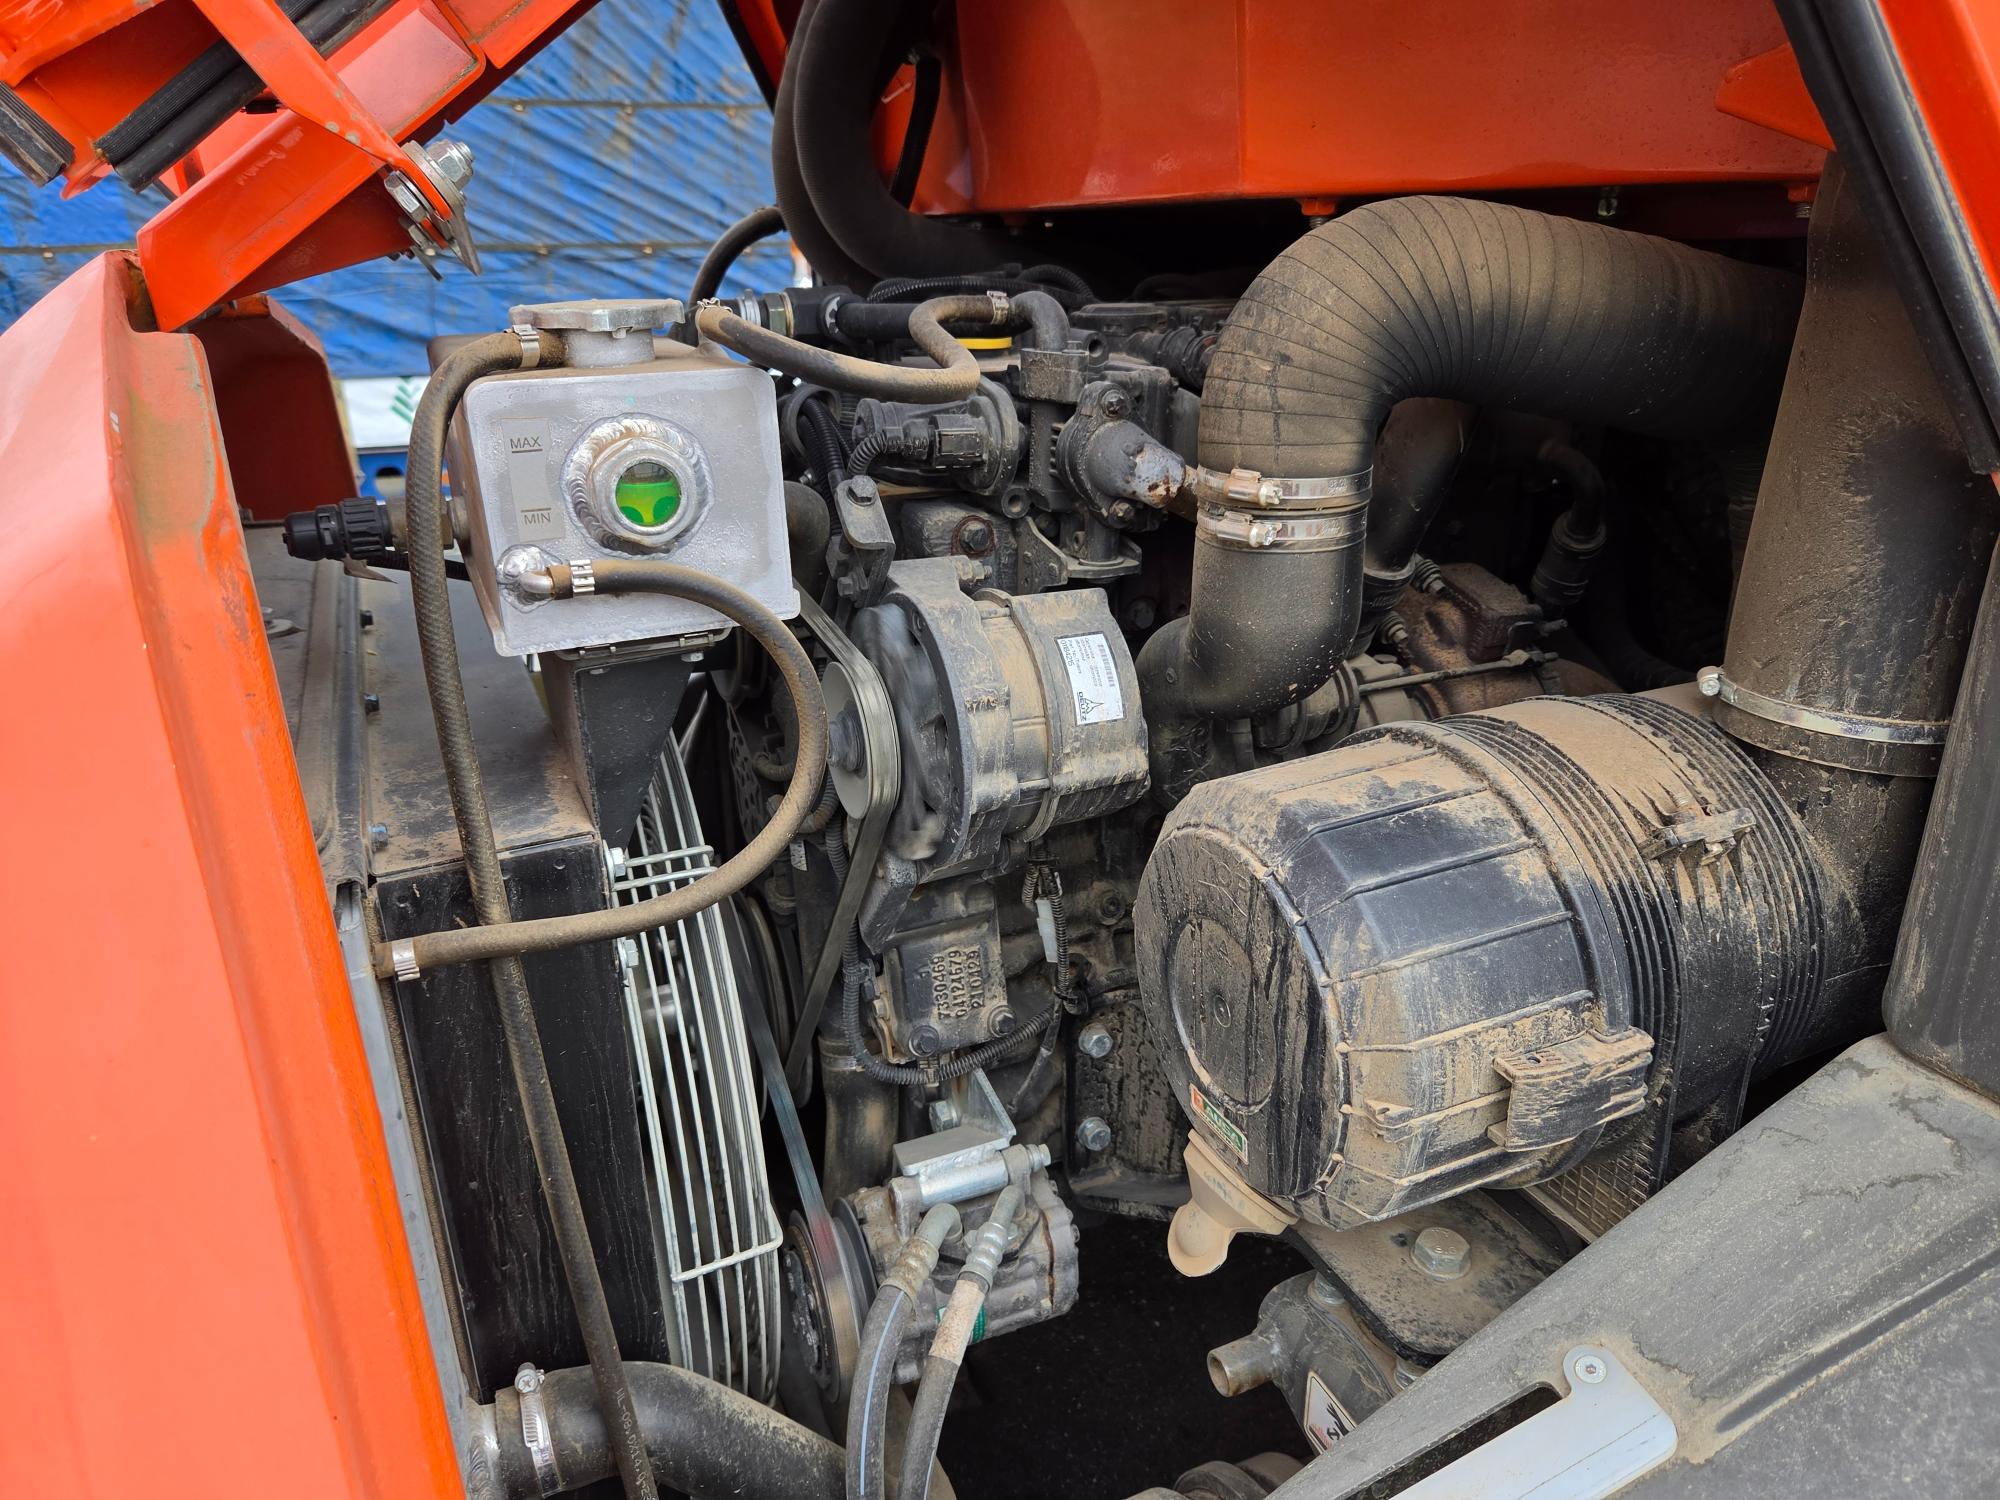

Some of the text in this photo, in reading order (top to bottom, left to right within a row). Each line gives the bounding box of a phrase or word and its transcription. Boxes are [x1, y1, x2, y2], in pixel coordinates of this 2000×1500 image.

[509, 436, 541, 449] MAX
[523, 512, 551, 525] MIN
[1078, 691, 1087, 721] DEUTZ
